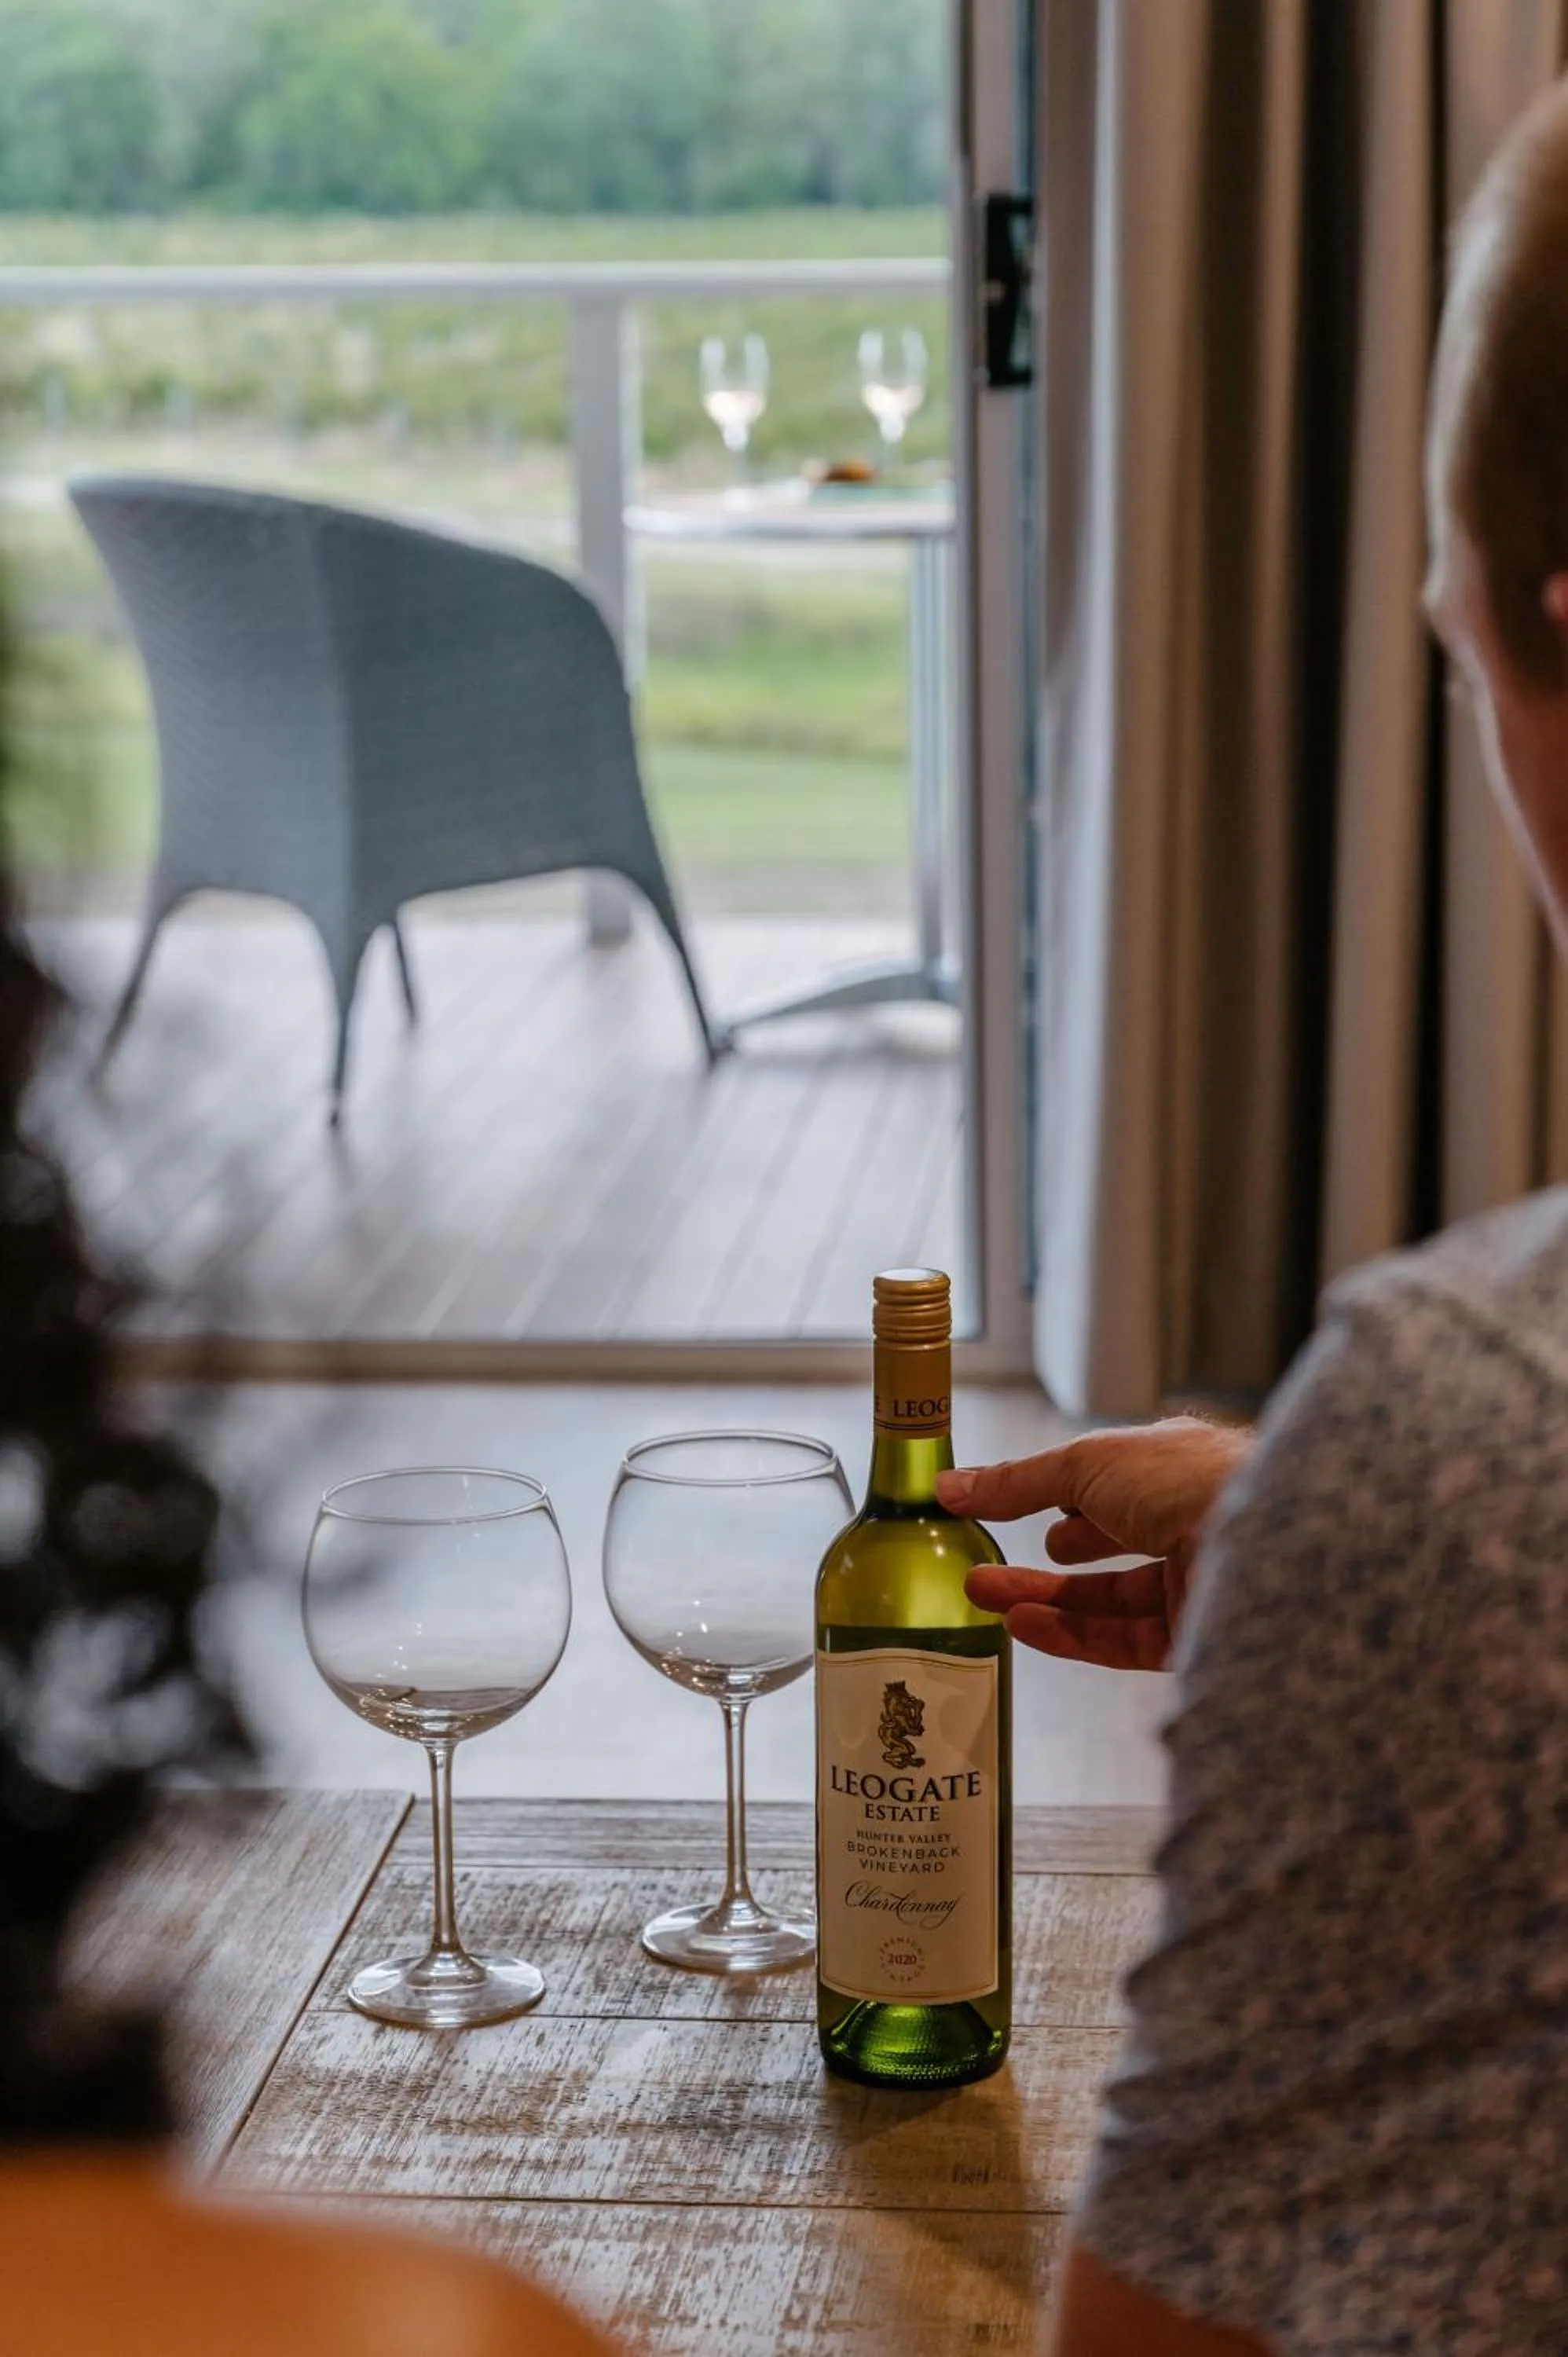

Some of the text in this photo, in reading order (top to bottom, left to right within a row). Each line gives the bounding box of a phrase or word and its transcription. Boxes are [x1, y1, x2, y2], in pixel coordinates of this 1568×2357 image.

[830, 1765, 982, 1803] LEOGATE
[865, 1803, 941, 1822] ESTATE
[856, 1828, 951, 1844] HUNTER VALLEY
[848, 1841, 961, 1860] BROKENBACK
[859, 1858, 945, 1874] VINEYARD
[844, 1879, 966, 1930] Chardonnay
[887, 1953, 918, 1965] 2020
